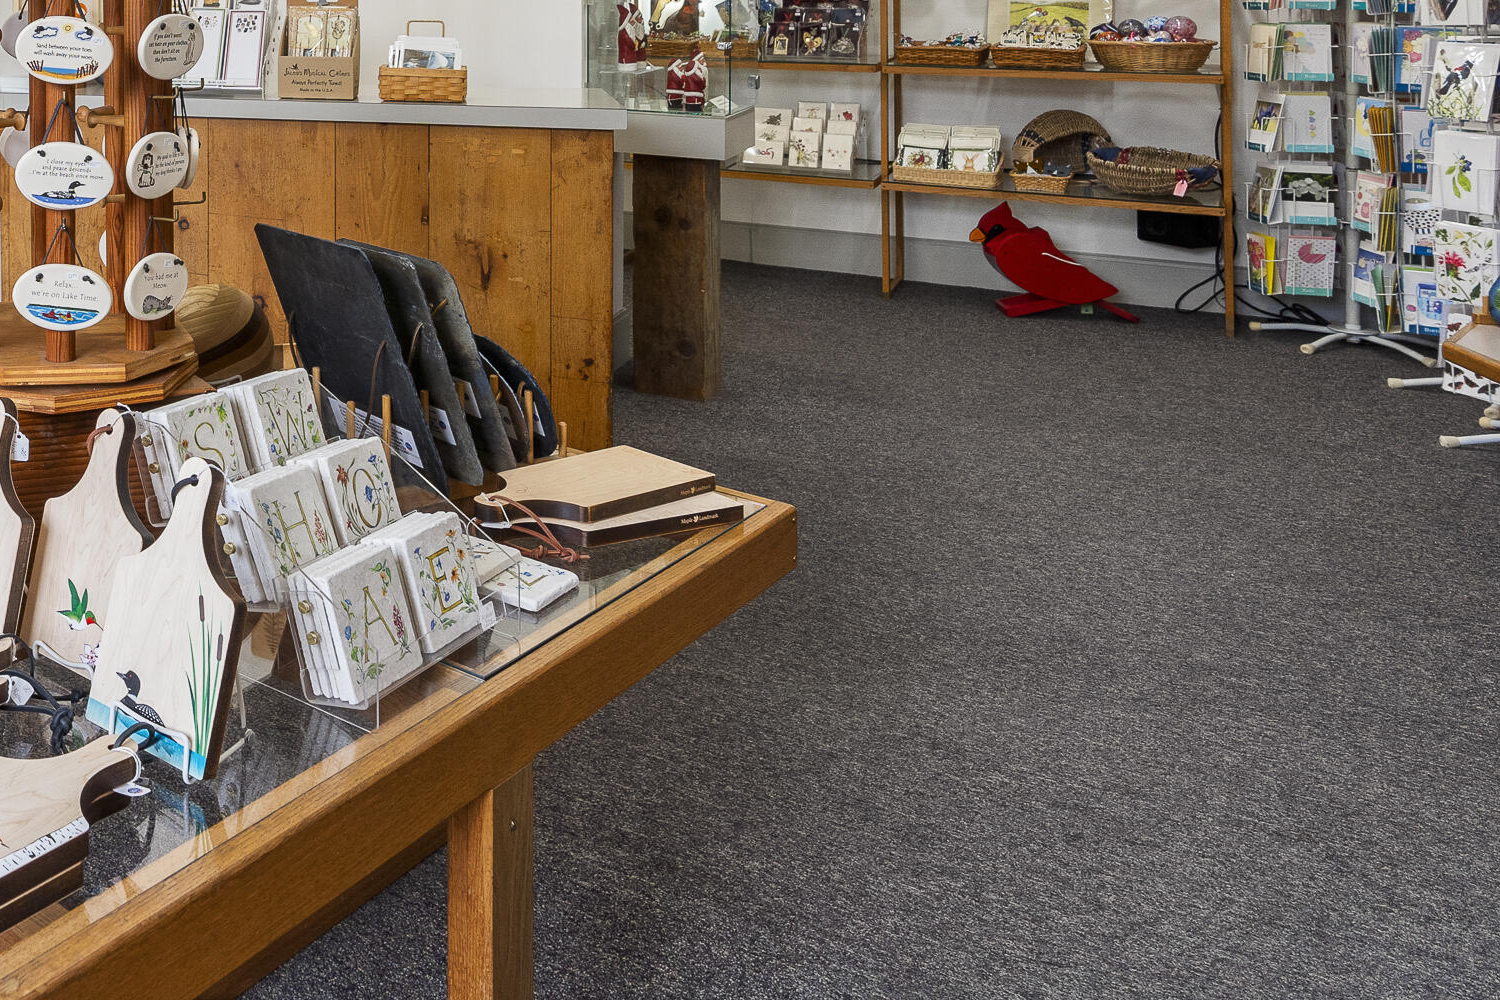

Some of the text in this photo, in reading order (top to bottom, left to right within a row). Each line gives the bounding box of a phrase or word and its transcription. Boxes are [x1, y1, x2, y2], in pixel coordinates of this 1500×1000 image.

[62, 292, 78, 300] Lake
[80, 294, 98, 302] Time.
[194, 421, 226, 472] S
[265, 390, 308, 456] W
[271, 490, 319, 568] H
[352, 468, 382, 529] O
[426, 546, 463, 614] E
[362, 586, 399, 663] A
